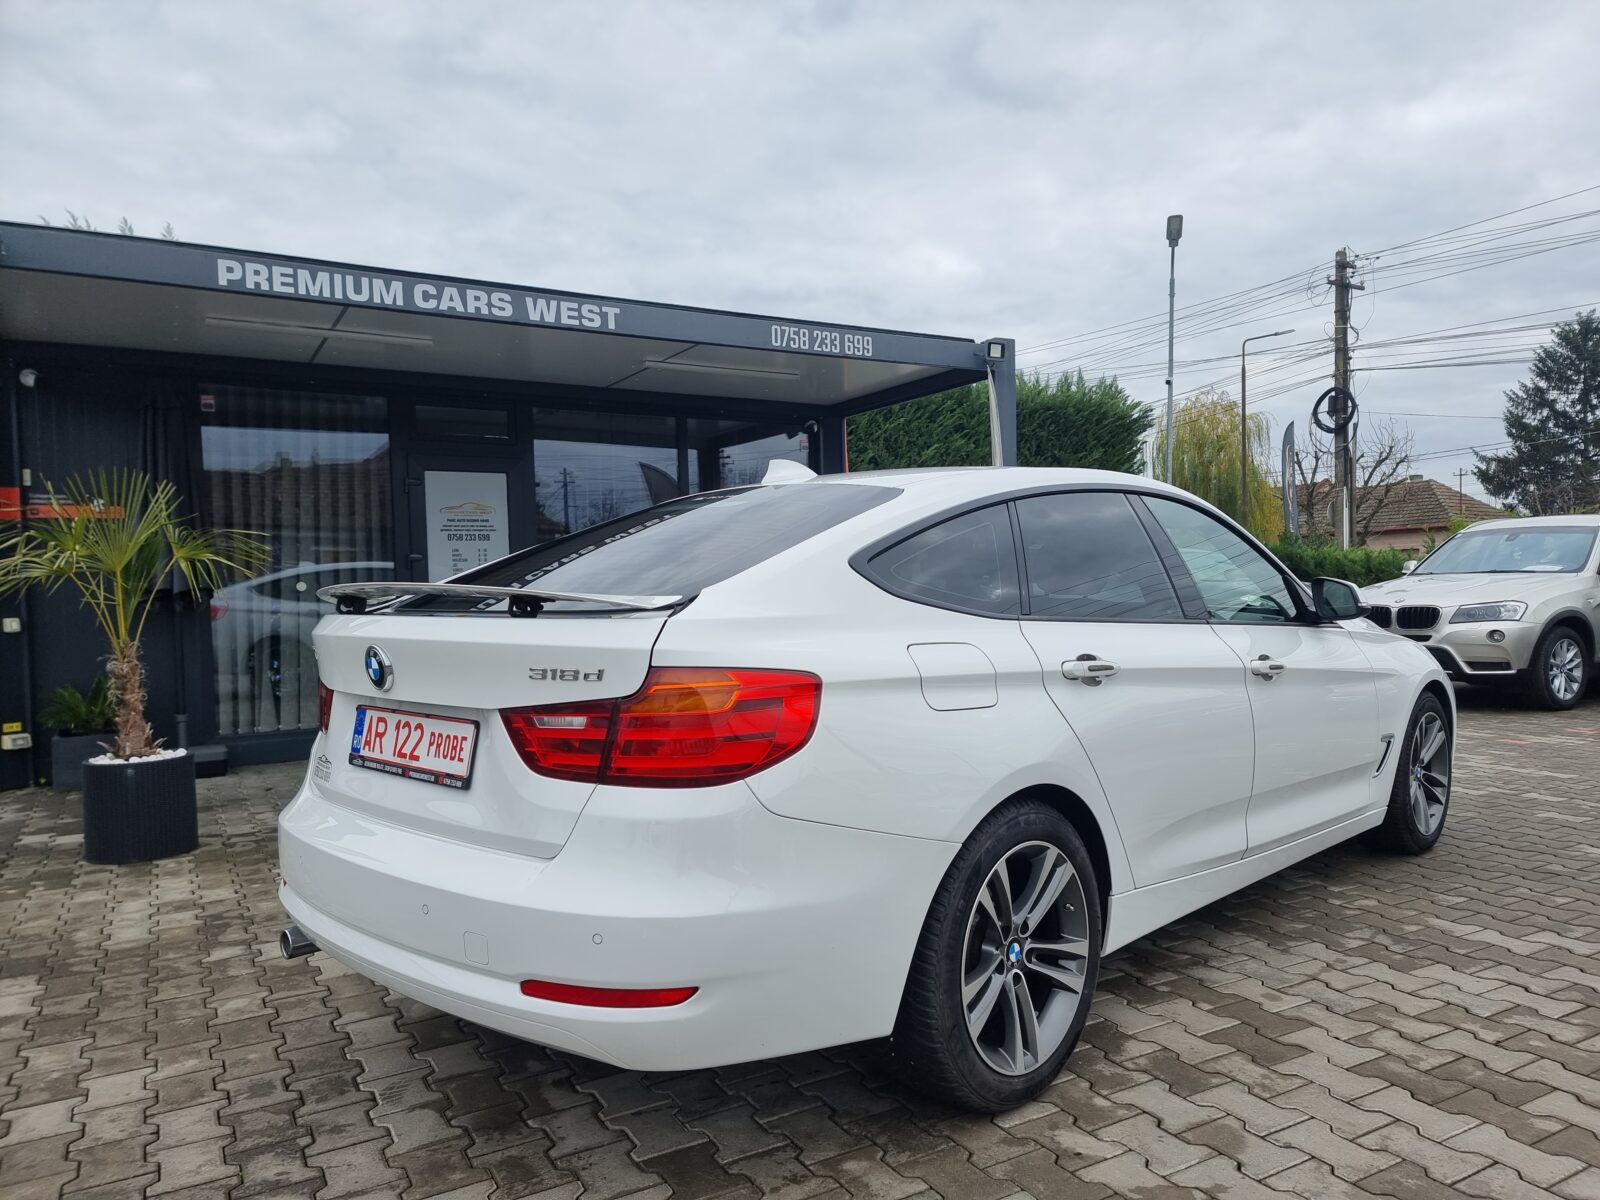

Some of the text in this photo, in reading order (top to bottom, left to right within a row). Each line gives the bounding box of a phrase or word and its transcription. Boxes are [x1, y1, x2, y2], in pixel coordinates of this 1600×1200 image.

[216, 258, 620, 330] PREMIUM CARS WEST
[771, 325, 873, 357] 0758 233 699
[447, 533, 490, 541] 0758 233 699
[528, 668, 604, 682] 318d
[352, 714, 468, 763] RO AR 122 PROBE
